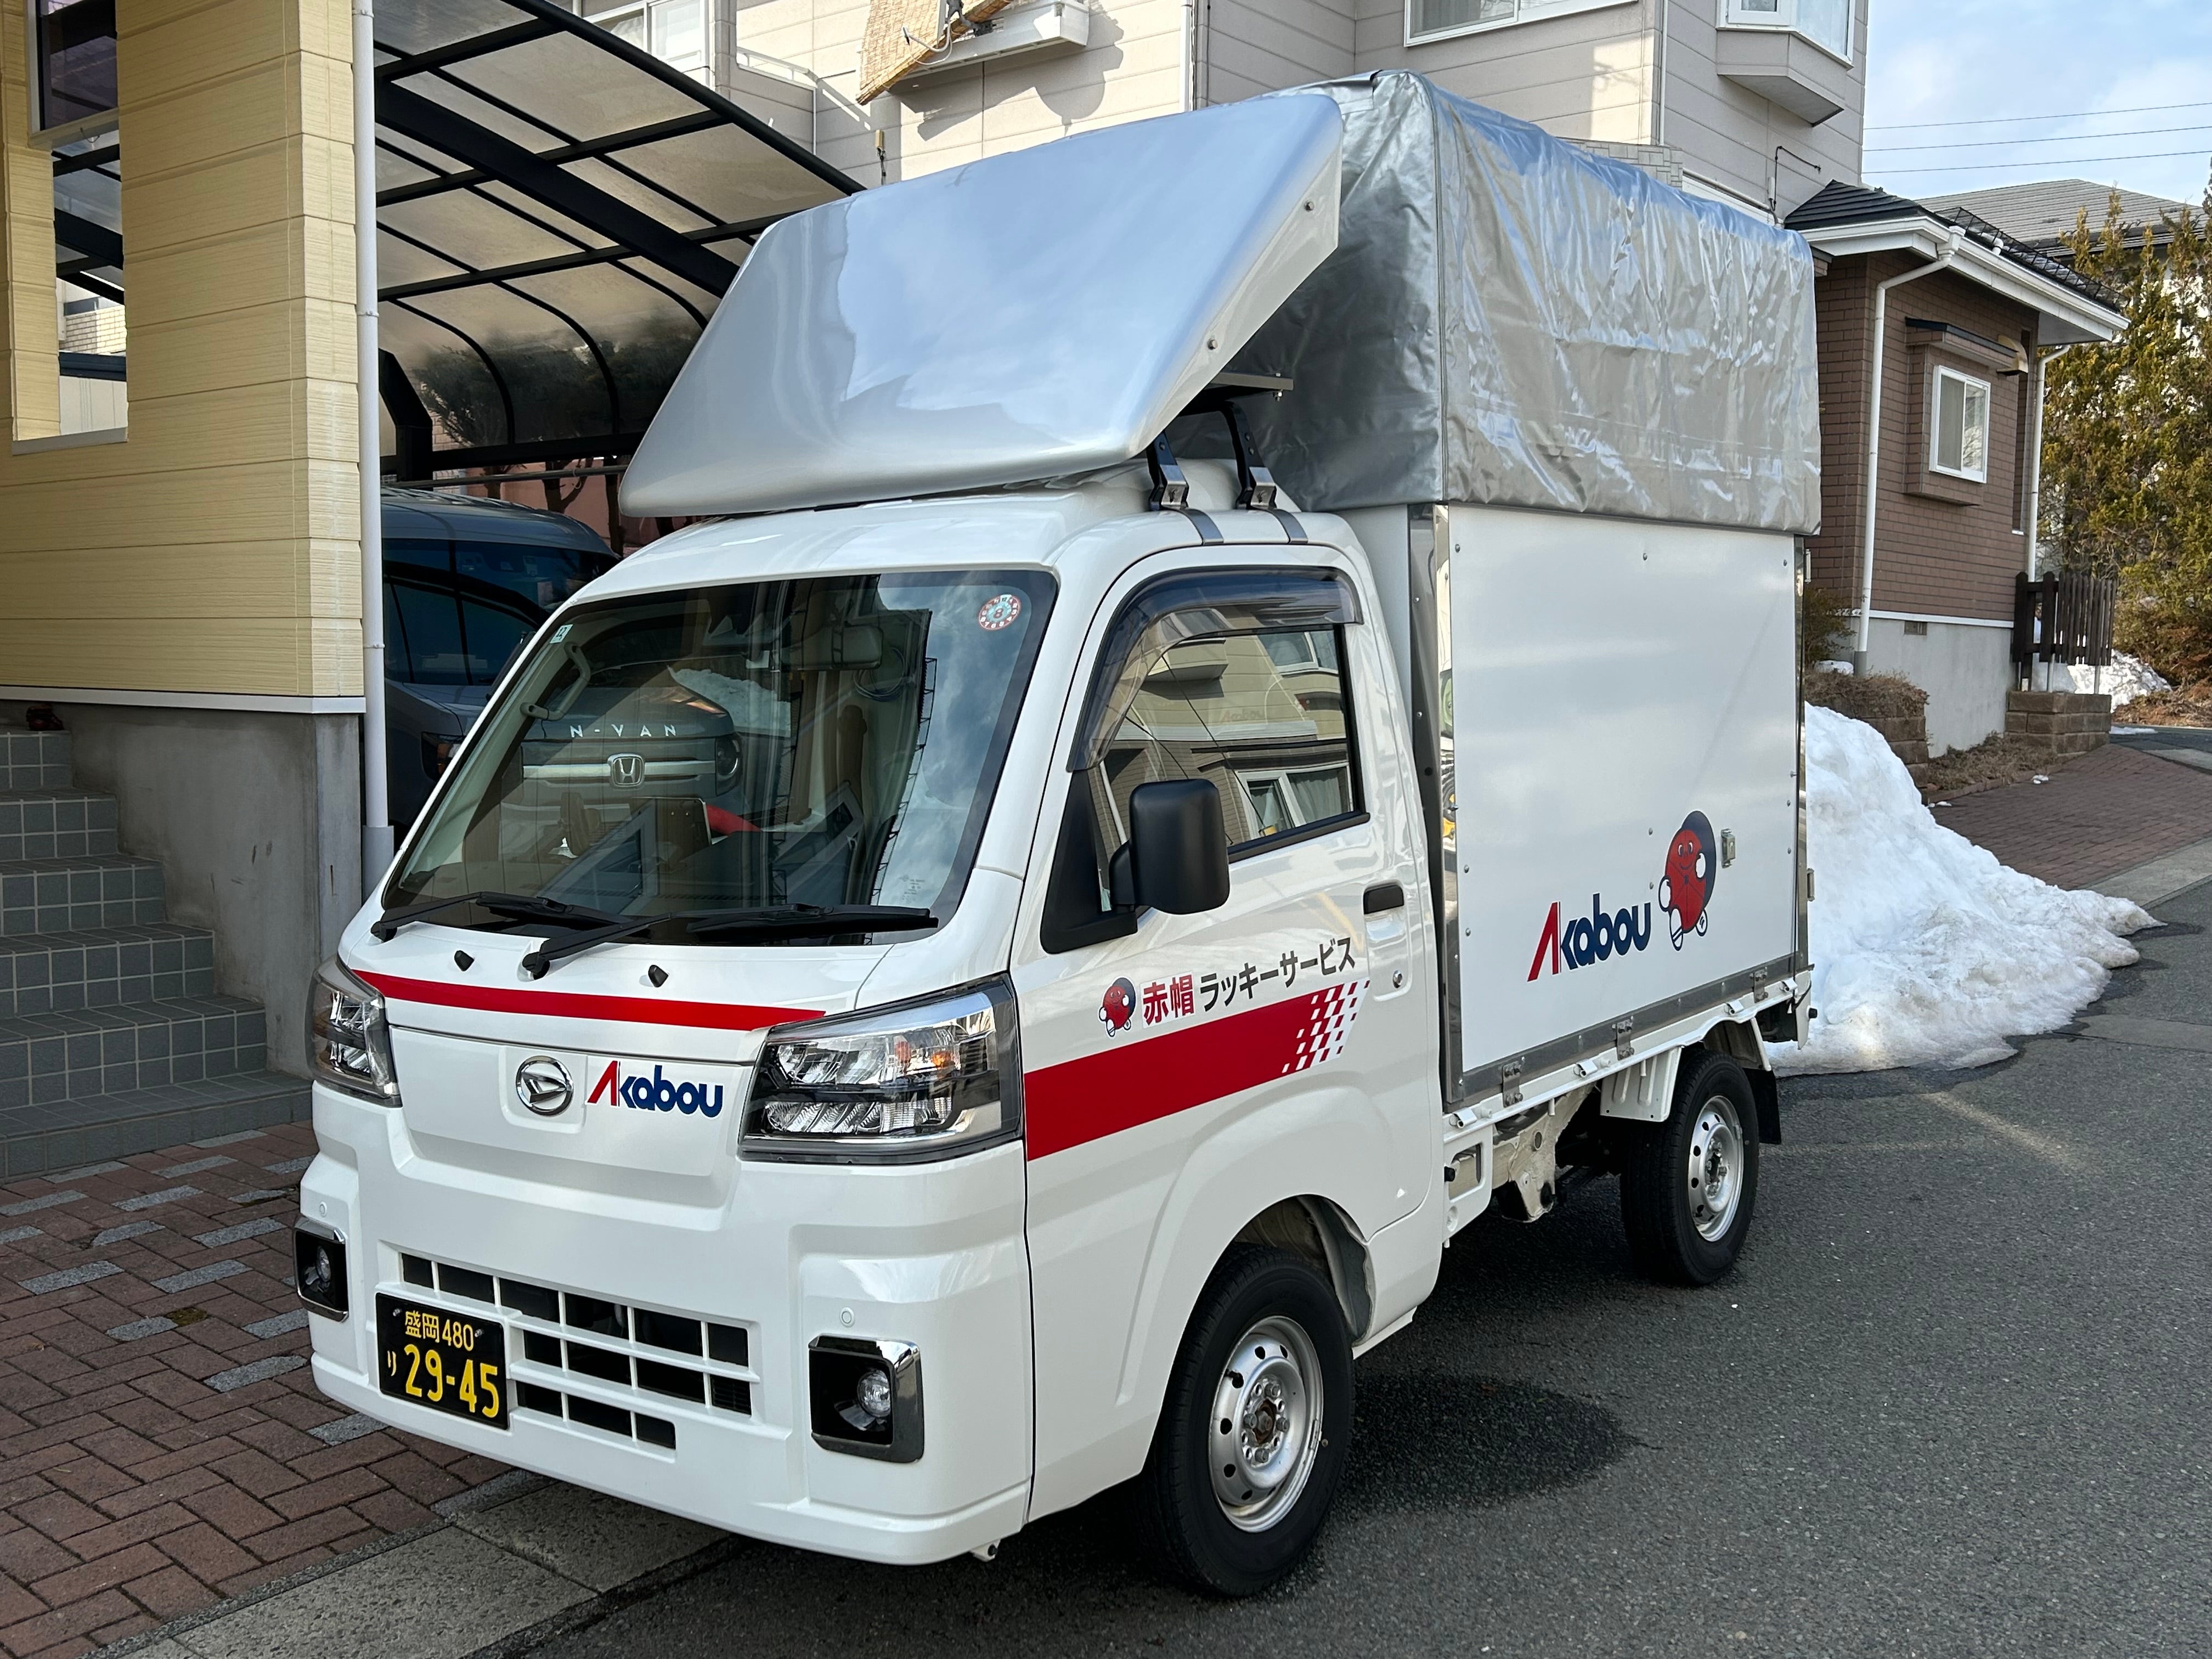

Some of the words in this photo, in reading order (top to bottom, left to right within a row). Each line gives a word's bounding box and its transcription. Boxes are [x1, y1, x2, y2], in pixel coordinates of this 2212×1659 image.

[993, 608, 1003, 618] 8
[569, 724, 676, 738] N-VAN
[1527, 893, 1651, 982] Akabou
[1142, 974, 1194, 1026] 赤帽
[1199, 936, 1356, 1012] ラッキーサービス
[587, 1060, 723, 1118] Akabou
[404, 1344, 499, 1419] 29-45
